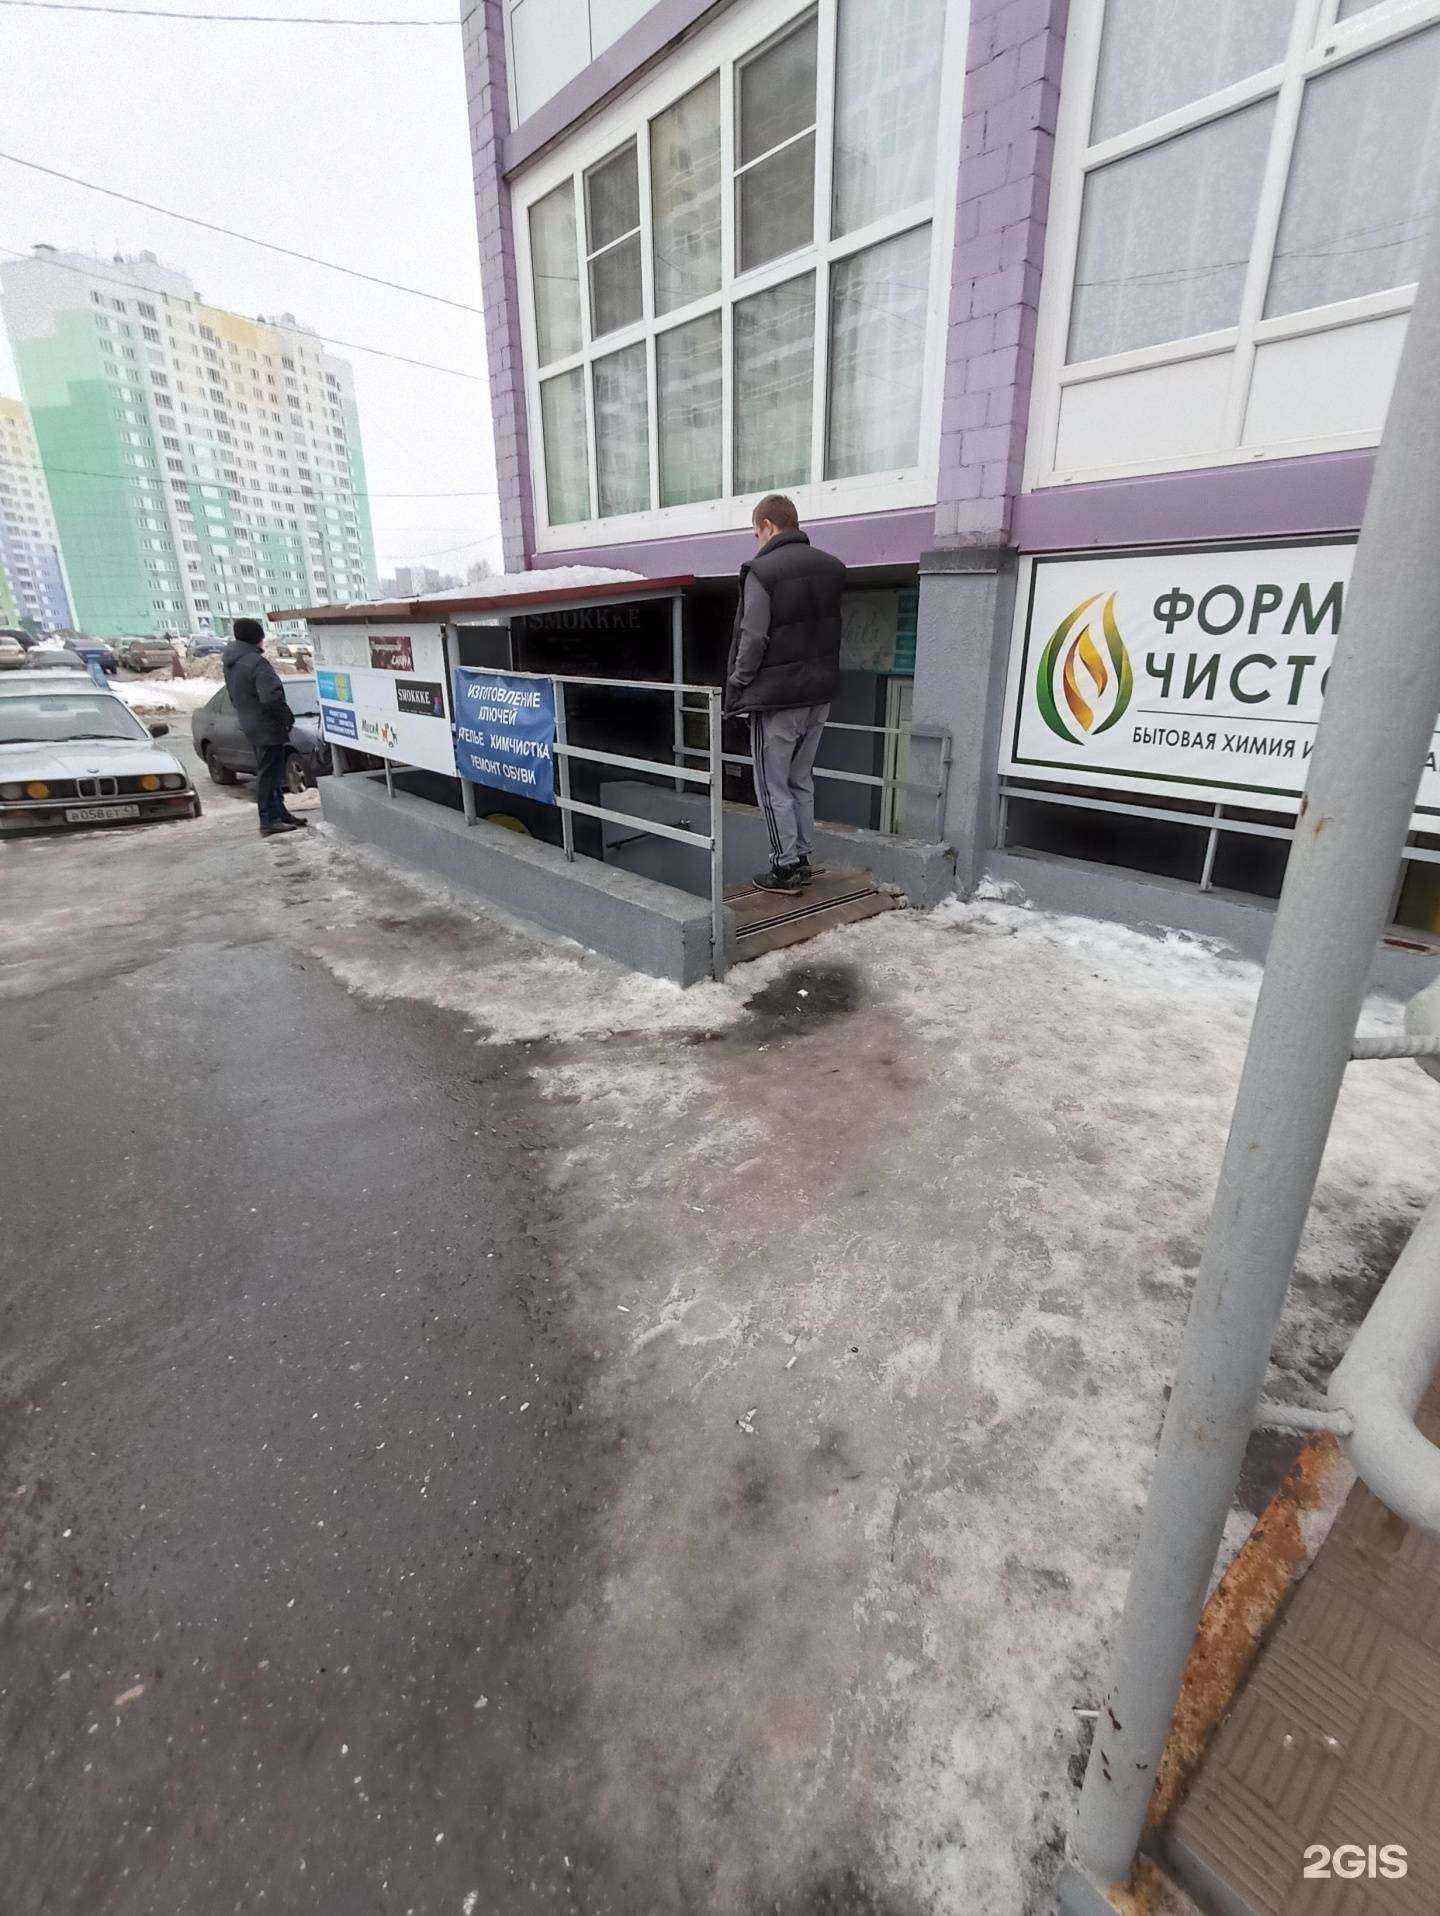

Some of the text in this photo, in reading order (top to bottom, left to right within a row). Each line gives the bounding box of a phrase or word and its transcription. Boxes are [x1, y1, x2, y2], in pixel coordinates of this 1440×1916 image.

[1145, 652, 1331, 706] ЧИСТ
[467, 683, 541, 708] ИЗГОТОВЛЕНИЕ
[490, 733, 551, 760] ХИМЧИСТКА
[1132, 726, 1217, 751] БЫТОВАЯ
[1220, 733, 1297, 759] ХИМИЯ
[502, 763, 537, 786] ОБУВИ
